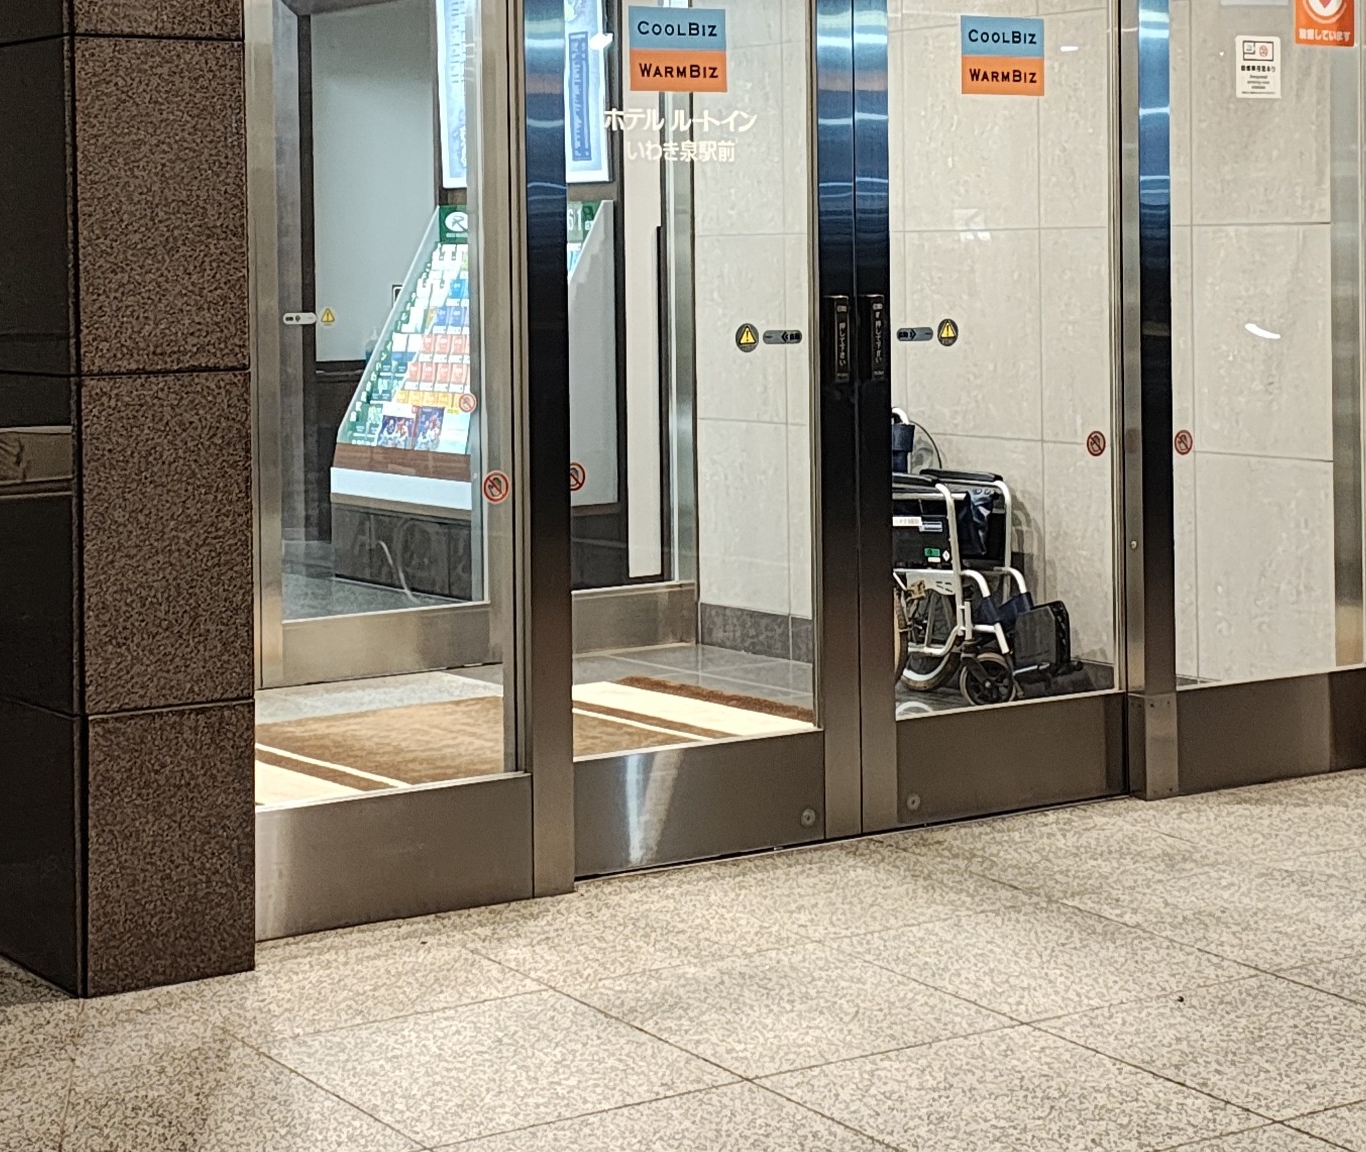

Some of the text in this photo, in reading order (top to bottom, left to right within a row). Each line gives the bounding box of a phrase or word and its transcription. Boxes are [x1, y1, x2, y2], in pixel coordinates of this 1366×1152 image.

[603, 108, 758, 132] ホテル ルートイン
[627, 140, 736, 163] いわき泉駅前
